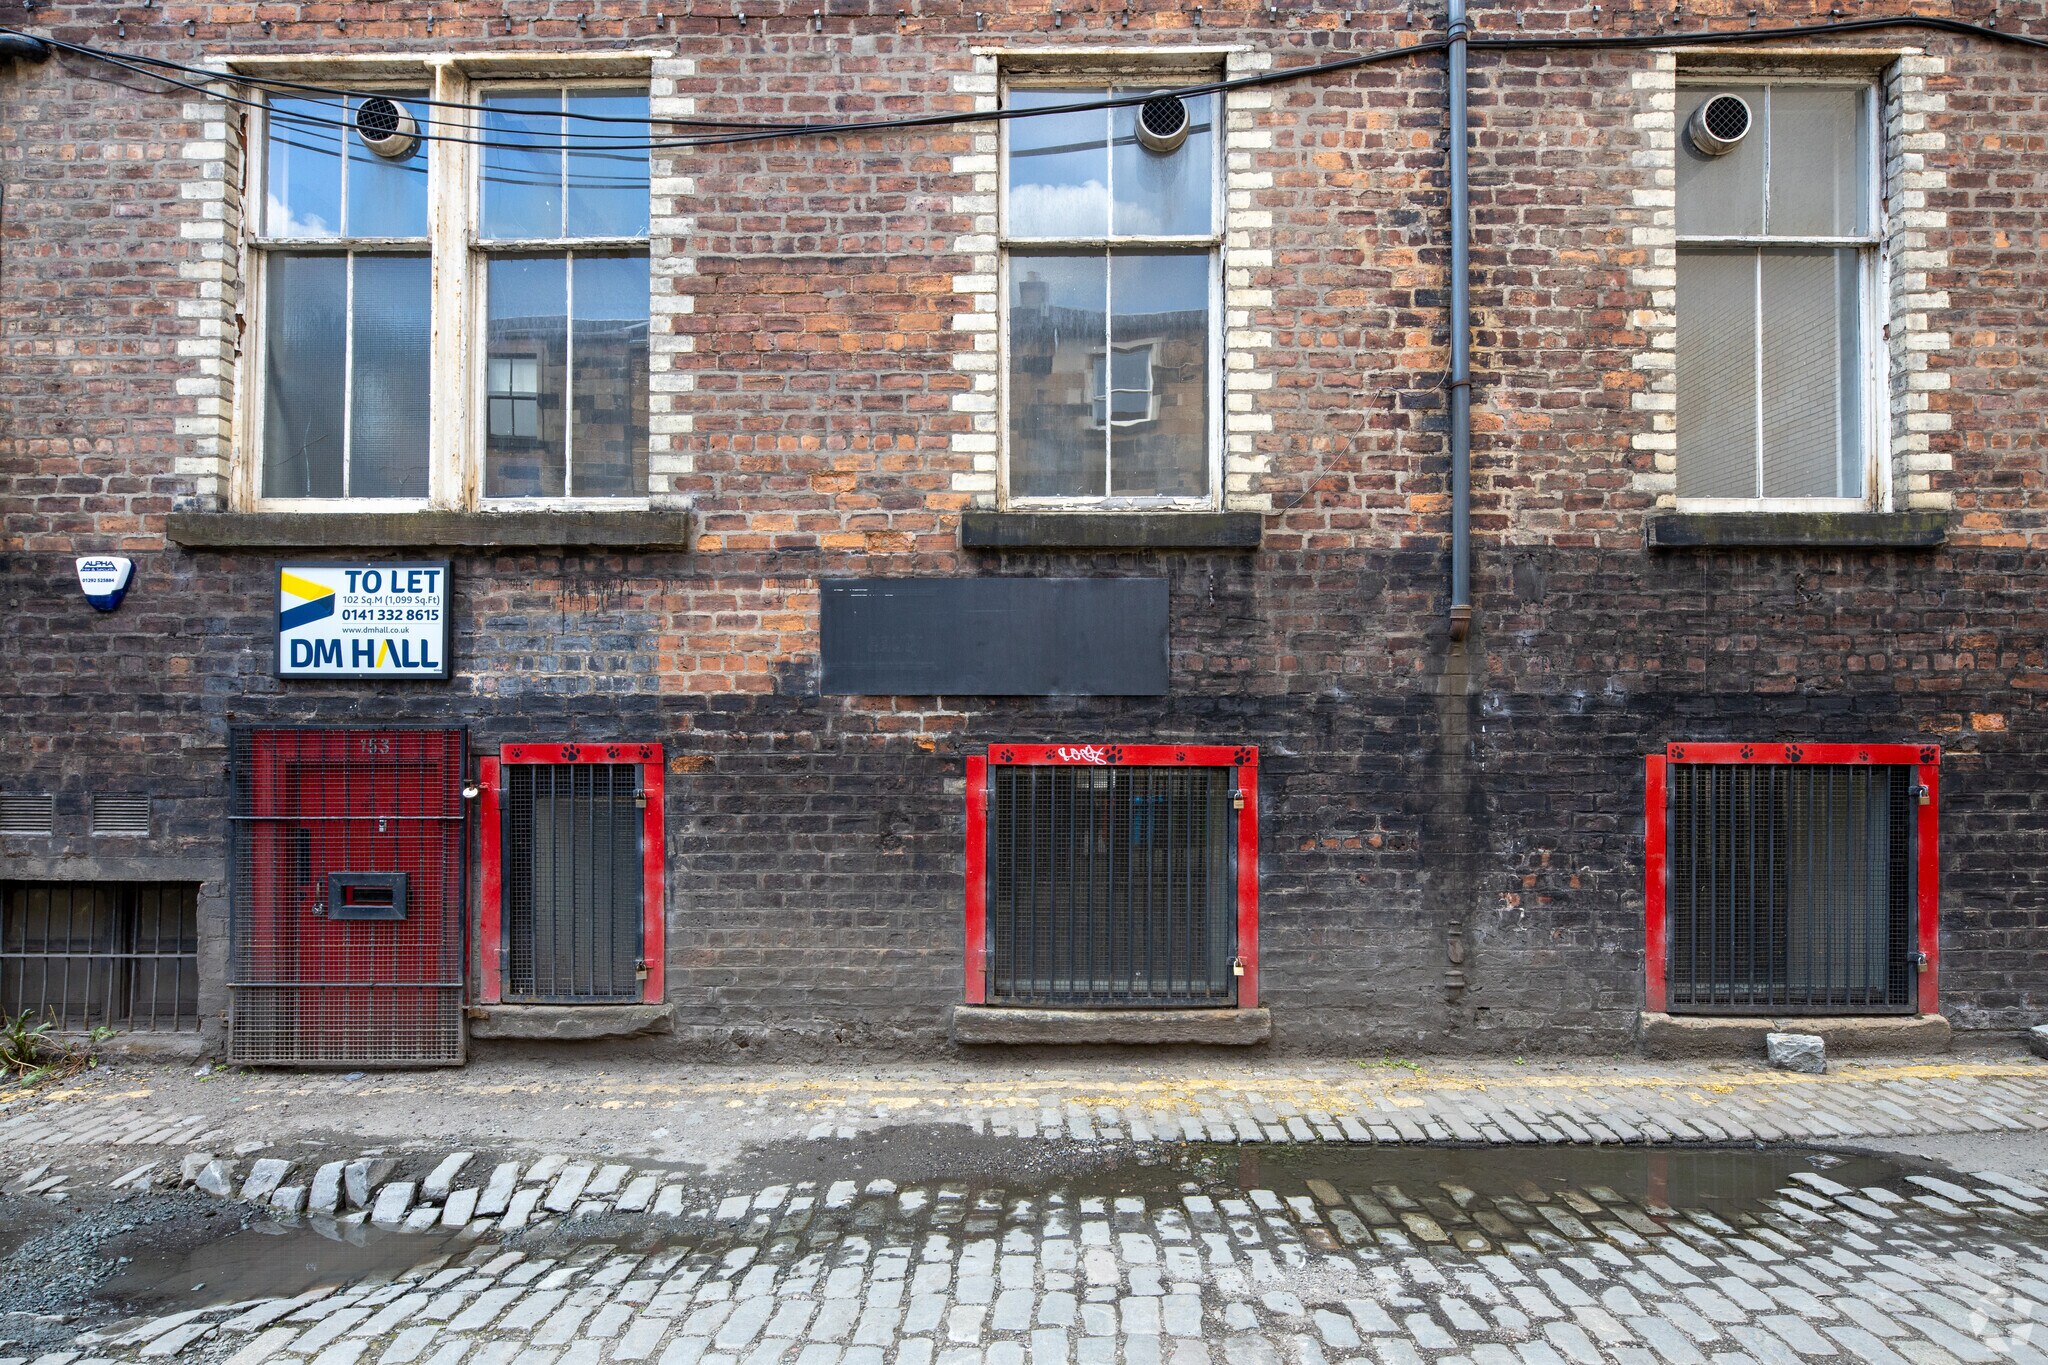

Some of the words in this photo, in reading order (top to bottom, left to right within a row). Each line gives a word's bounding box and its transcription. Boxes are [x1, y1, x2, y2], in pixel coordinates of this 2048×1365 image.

[345, 570, 382, 594] TO
[391, 570, 440, 593] LET
[342, 596, 359, 604] 102
[361, 596, 383, 606] Sq.M
[385, 595, 413, 606] (1,099
[414, 595, 440, 606] Sq.Ft)
[342, 609, 374, 621] 0141
[377, 609, 403, 621] 332
[406, 609, 439, 621] 8615
[342, 626, 410, 634] www.dmhall.co.uk
[290, 638, 343, 668] DM
[352, 638, 439, 668] HALL
[360, 738, 390, 755] 153
